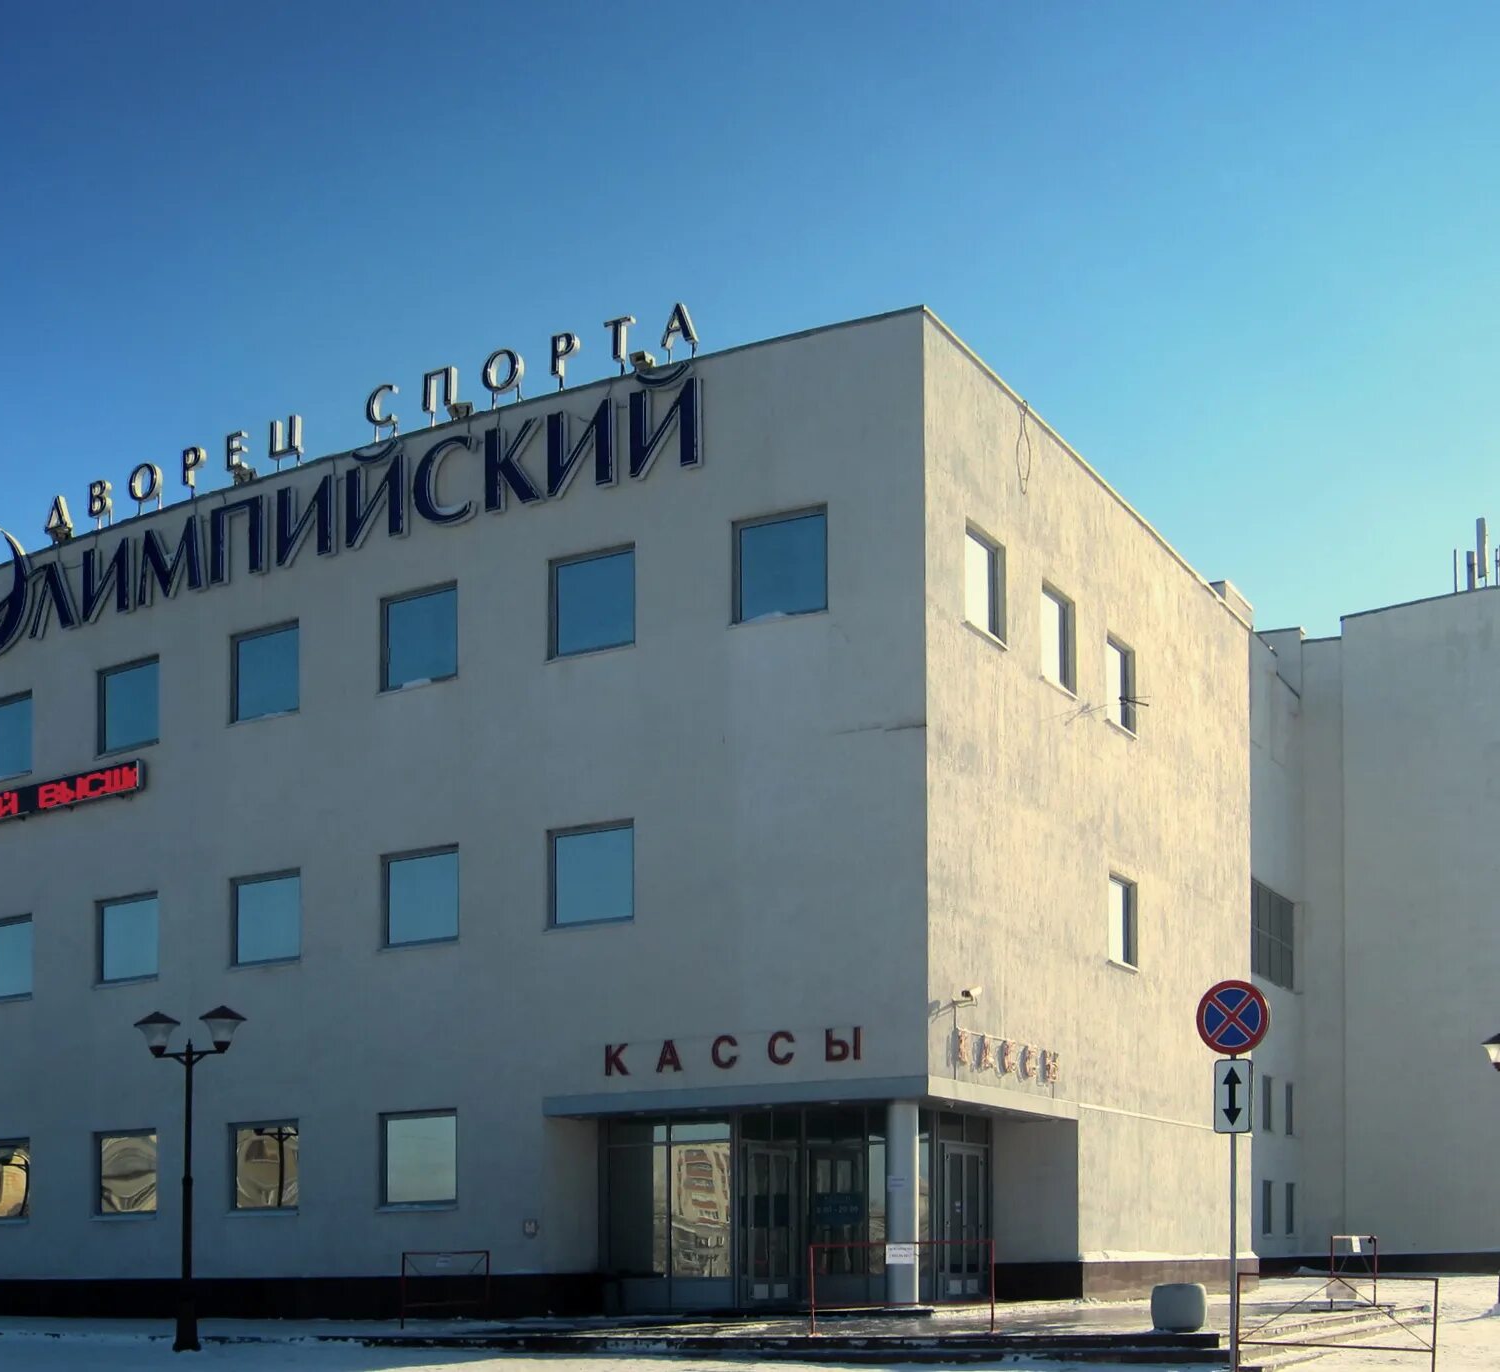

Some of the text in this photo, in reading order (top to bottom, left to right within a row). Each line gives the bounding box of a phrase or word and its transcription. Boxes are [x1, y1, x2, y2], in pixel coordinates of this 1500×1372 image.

[43, 302, 698, 539] ДВОРЕЦ СПОРТА
[603, 1026, 863, 1077] КАССЫ
